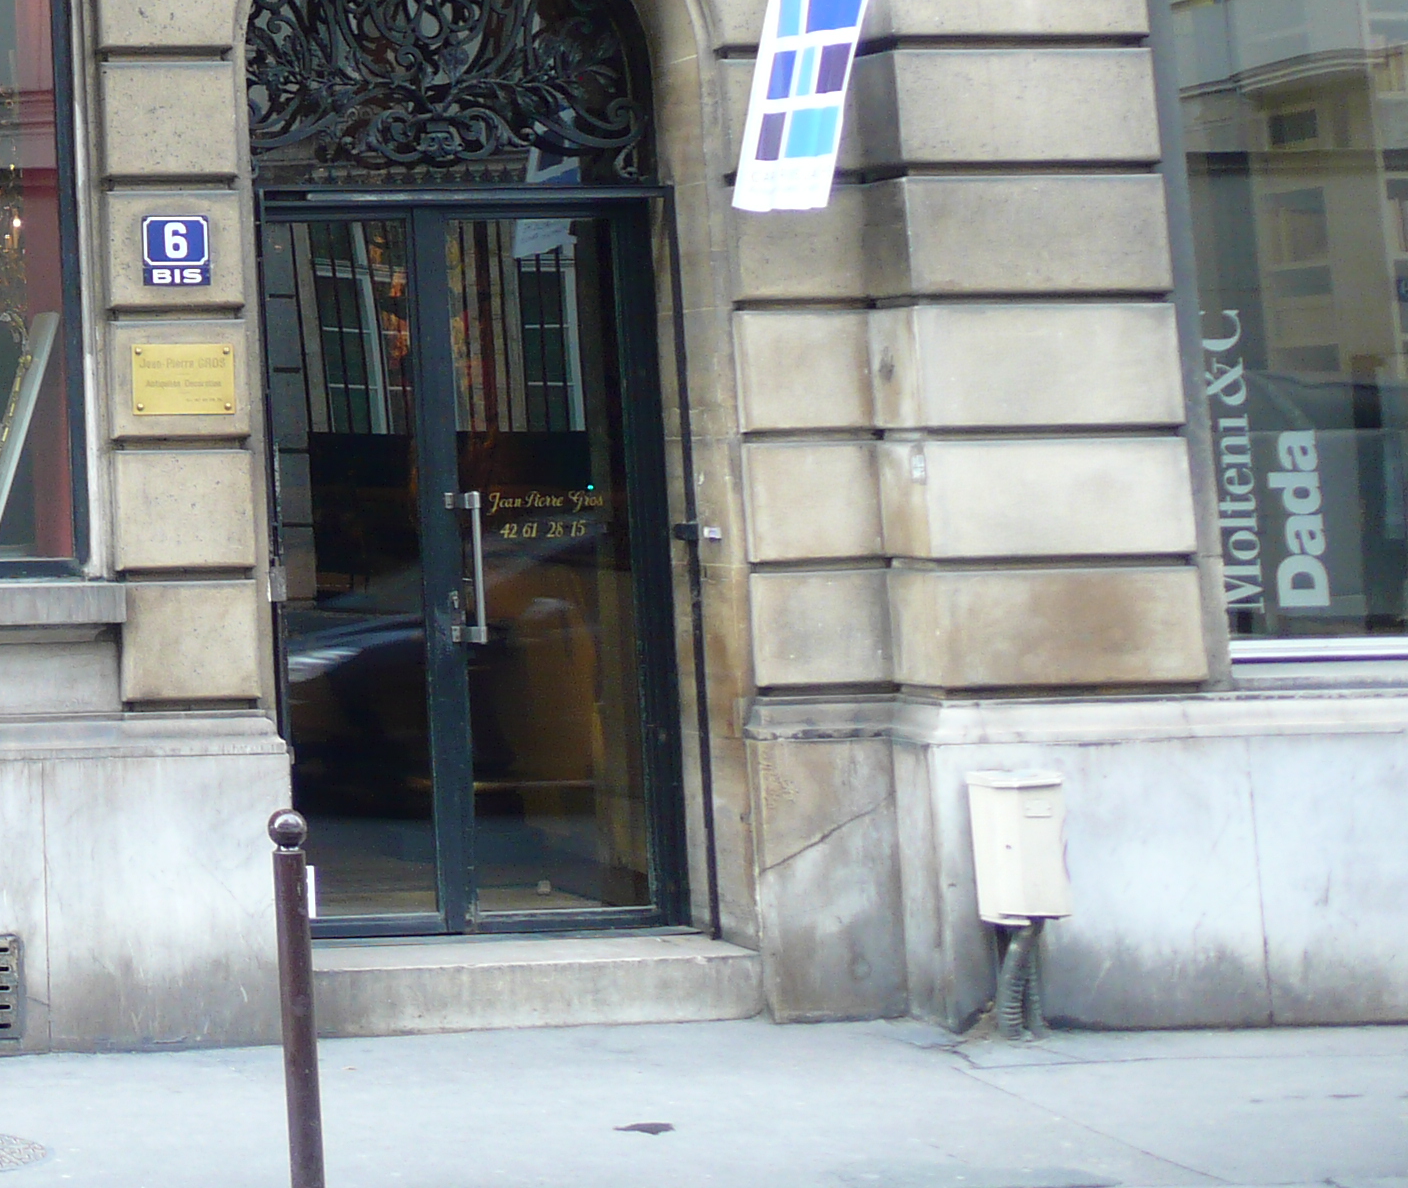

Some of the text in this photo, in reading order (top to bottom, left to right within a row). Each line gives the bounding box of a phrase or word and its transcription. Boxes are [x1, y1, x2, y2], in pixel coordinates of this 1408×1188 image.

[164, 222, 188, 259] 6
[152, 268, 203, 284] BIS
[568, 491, 604, 513] Gros
[1267, 428, 1331, 608] Dada
[500, 523, 518, 539] 42
[523, 522, 538, 538] 61
[571, 520, 587, 537] 15
